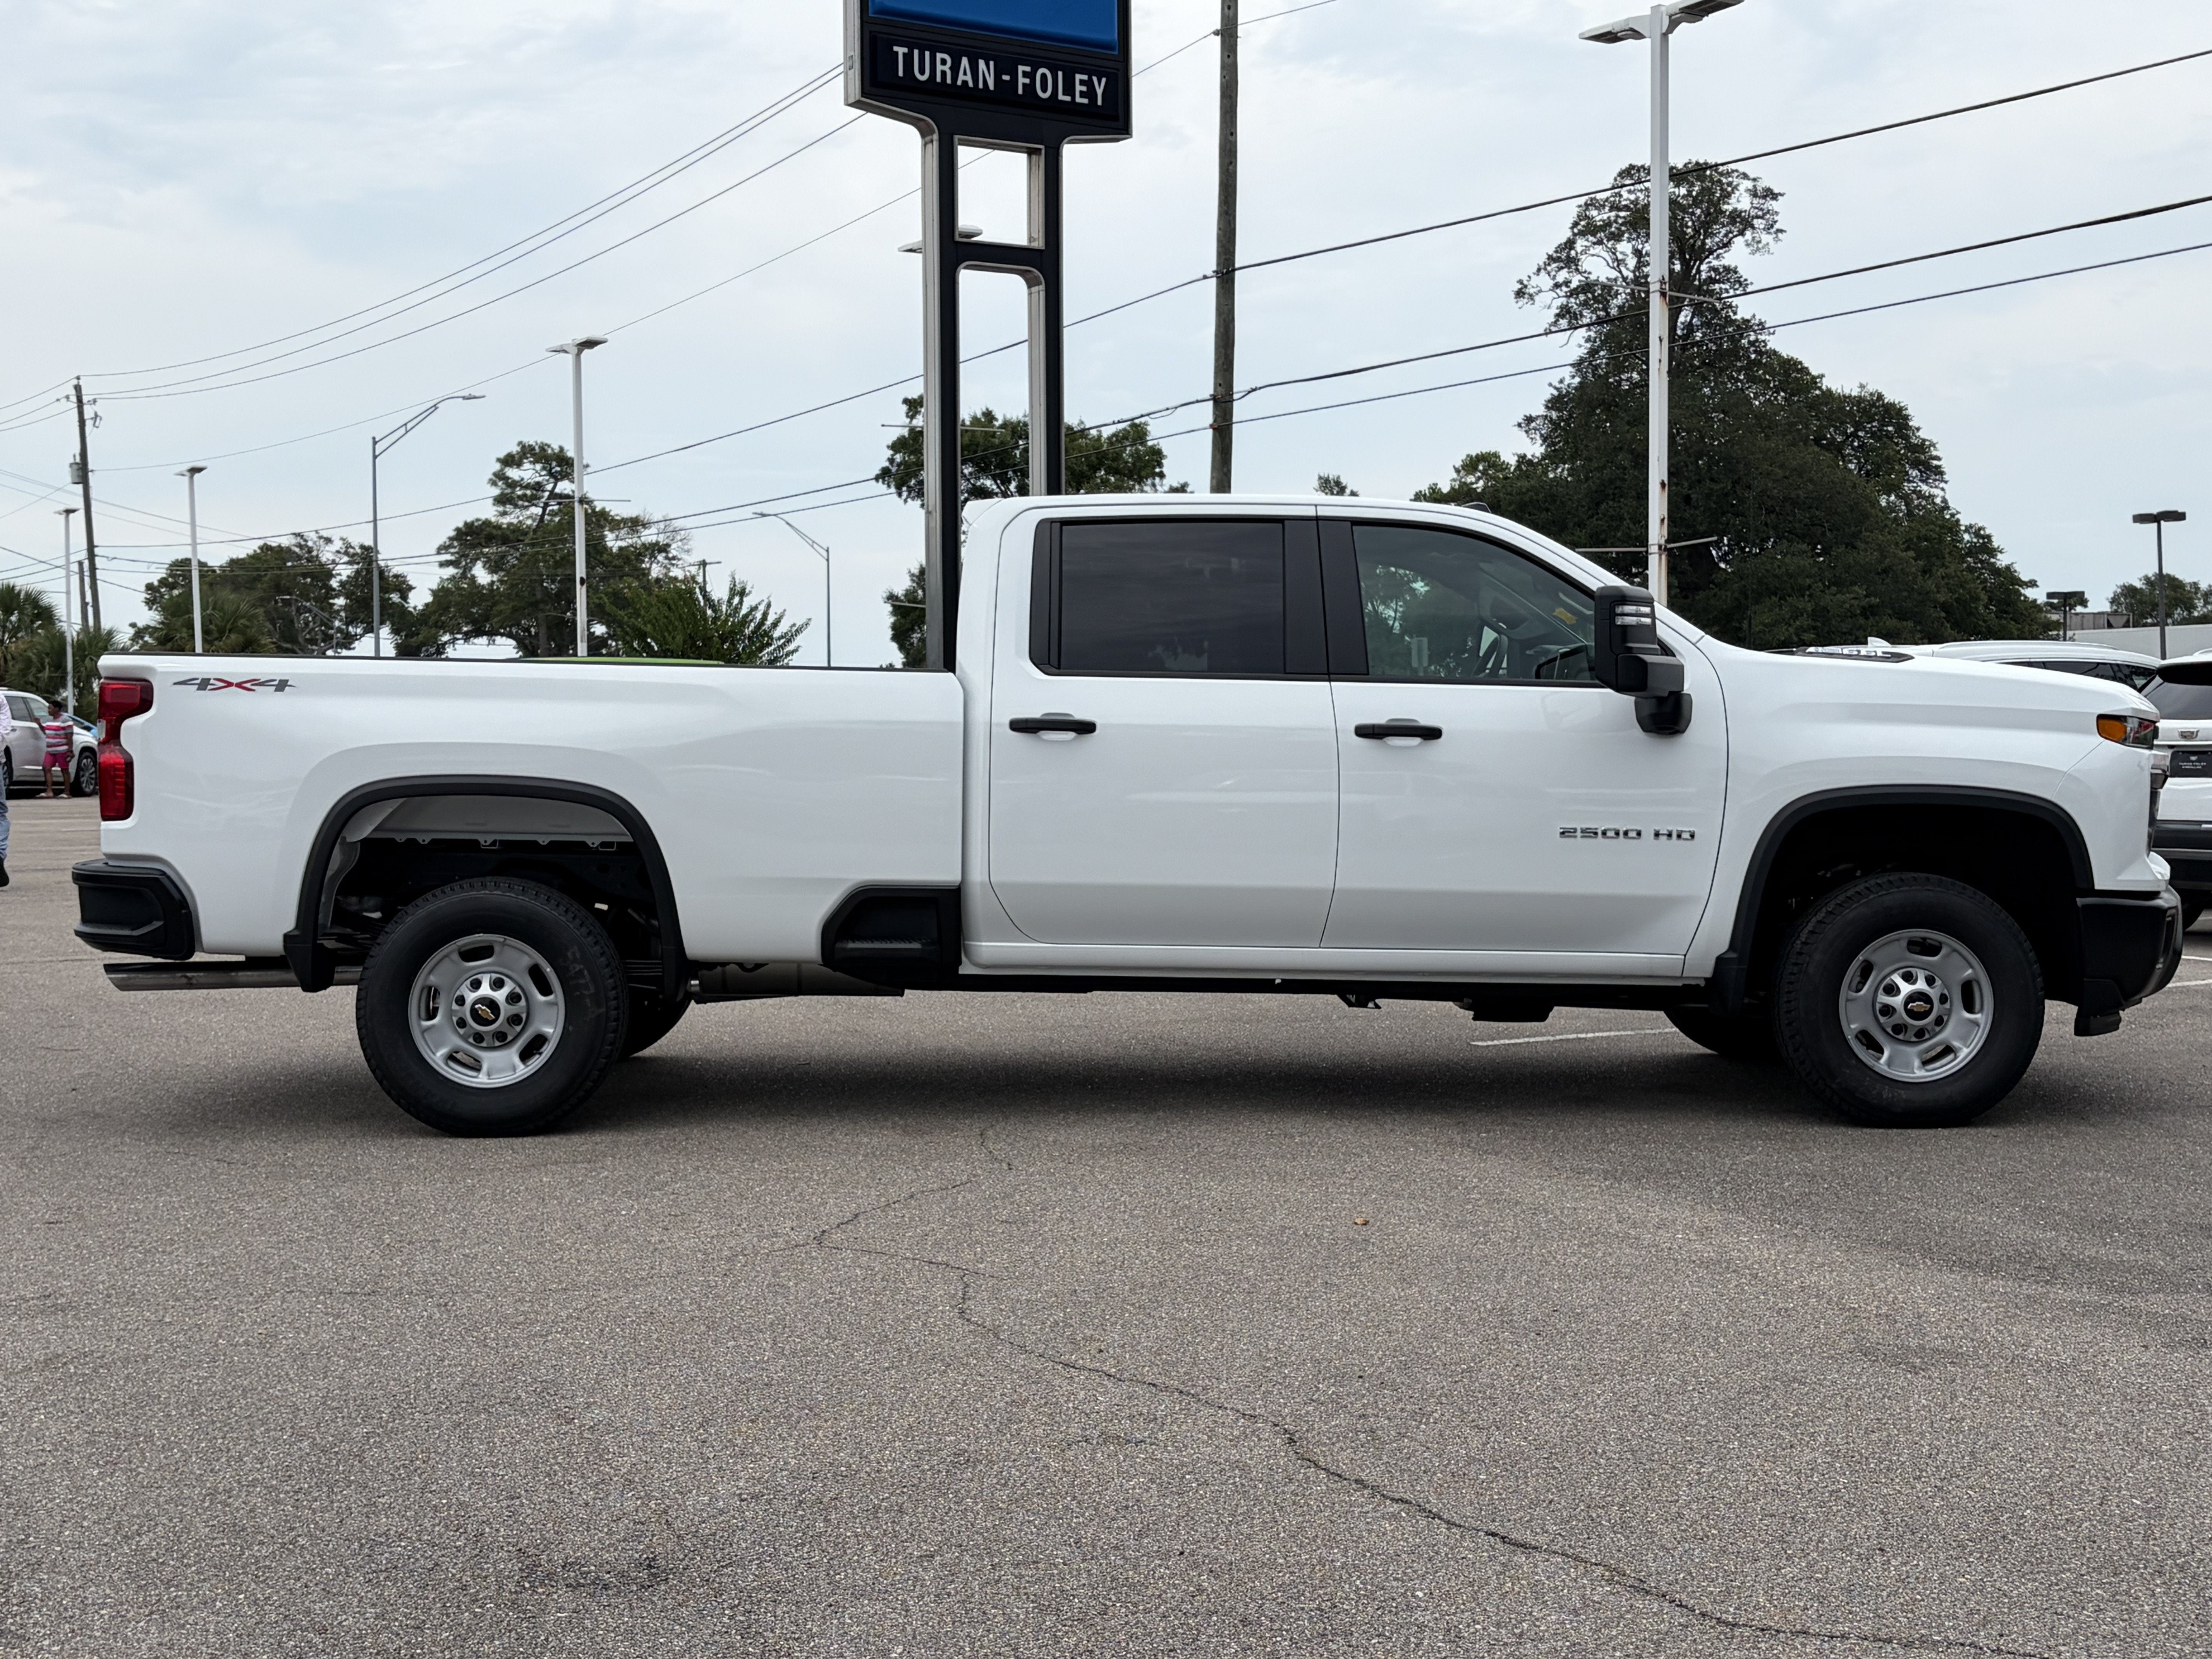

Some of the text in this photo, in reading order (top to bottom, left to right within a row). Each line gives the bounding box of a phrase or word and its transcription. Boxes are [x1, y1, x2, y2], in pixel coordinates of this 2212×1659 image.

[893, 46, 1106, 106] TURAN-FOLEY
[1559, 827, 1695, 841] 2500 HD
